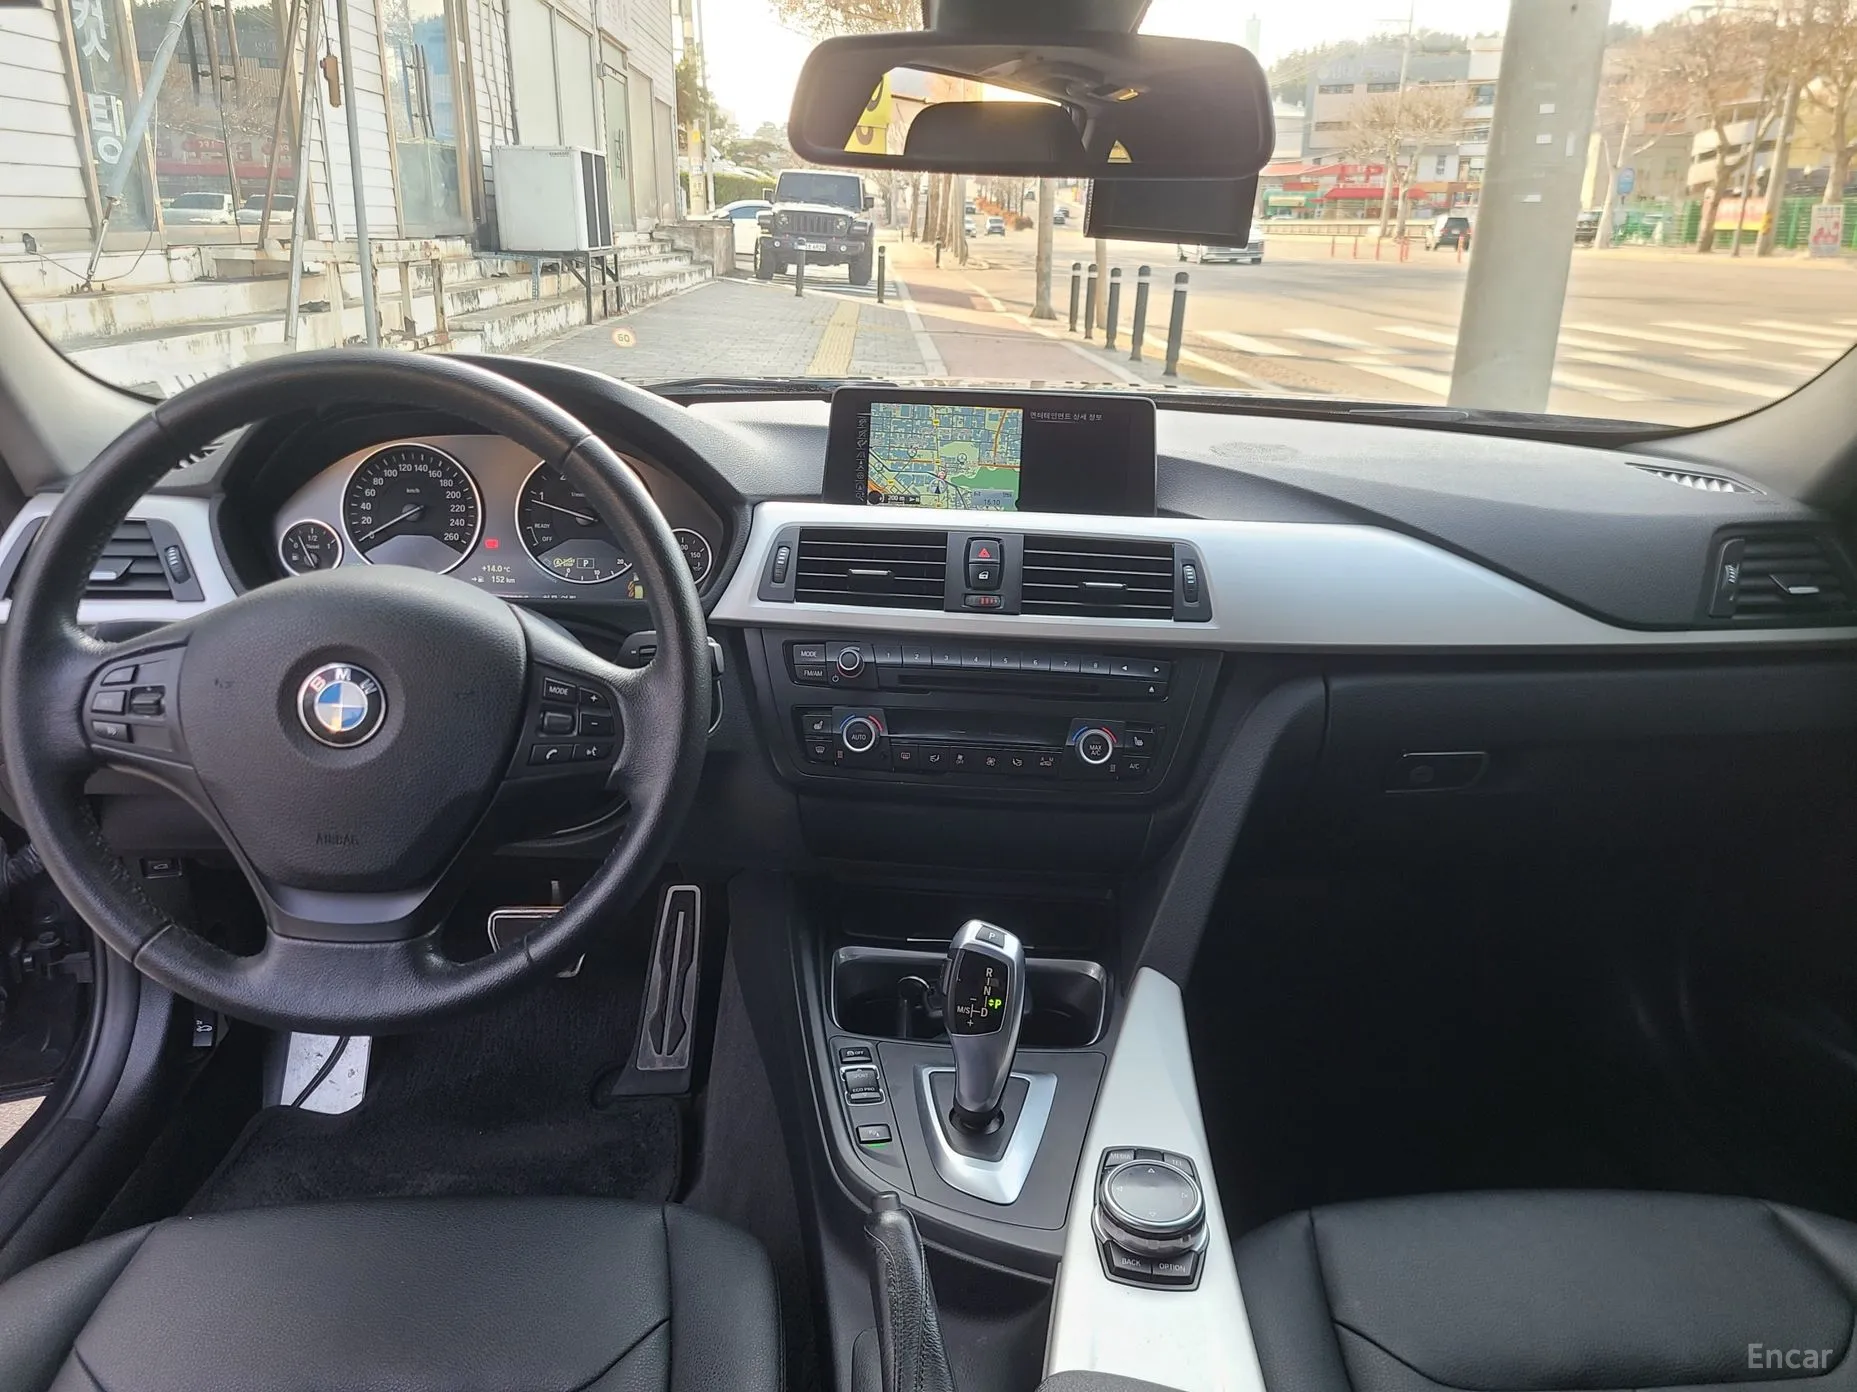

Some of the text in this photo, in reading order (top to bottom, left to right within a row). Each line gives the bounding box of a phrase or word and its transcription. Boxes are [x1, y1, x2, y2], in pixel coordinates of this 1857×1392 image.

[399, 464, 413, 472] 120
[415, 464, 429, 473] 140
[384, 470, 398, 478] 100
[429, 470, 442, 478] 160
[373, 478, 384, 486] 80
[440, 479, 454, 487] 180
[365, 489, 376, 497] 60
[446, 491, 461, 499] 200
[539, 491, 544, 501] 1
[360, 502, 372, 511] 40
[450, 504, 466, 513] 220
[361, 516, 372, 525] 20
[449, 519, 465, 527] 240
[444, 532, 459, 541] 260
[690, 551, 701, 559] 150
[583, 559, 589, 567] P
[800, 650, 817, 658] MODE
[309, 667, 378, 696] BMW
[548, 685, 569, 695] MODE
[851, 733, 867, 741] AUTO
[988, 932, 996, 940] P
[985, 967, 993, 978] R
[983, 985, 992, 996] N
[994, 999, 1002, 1010] P
[956, 1005, 971, 1014] M/S
[980, 1007, 989, 1018] D
[1121, 1257, 1141, 1267] BACK
[1159, 1262, 1186, 1273] OPTION
